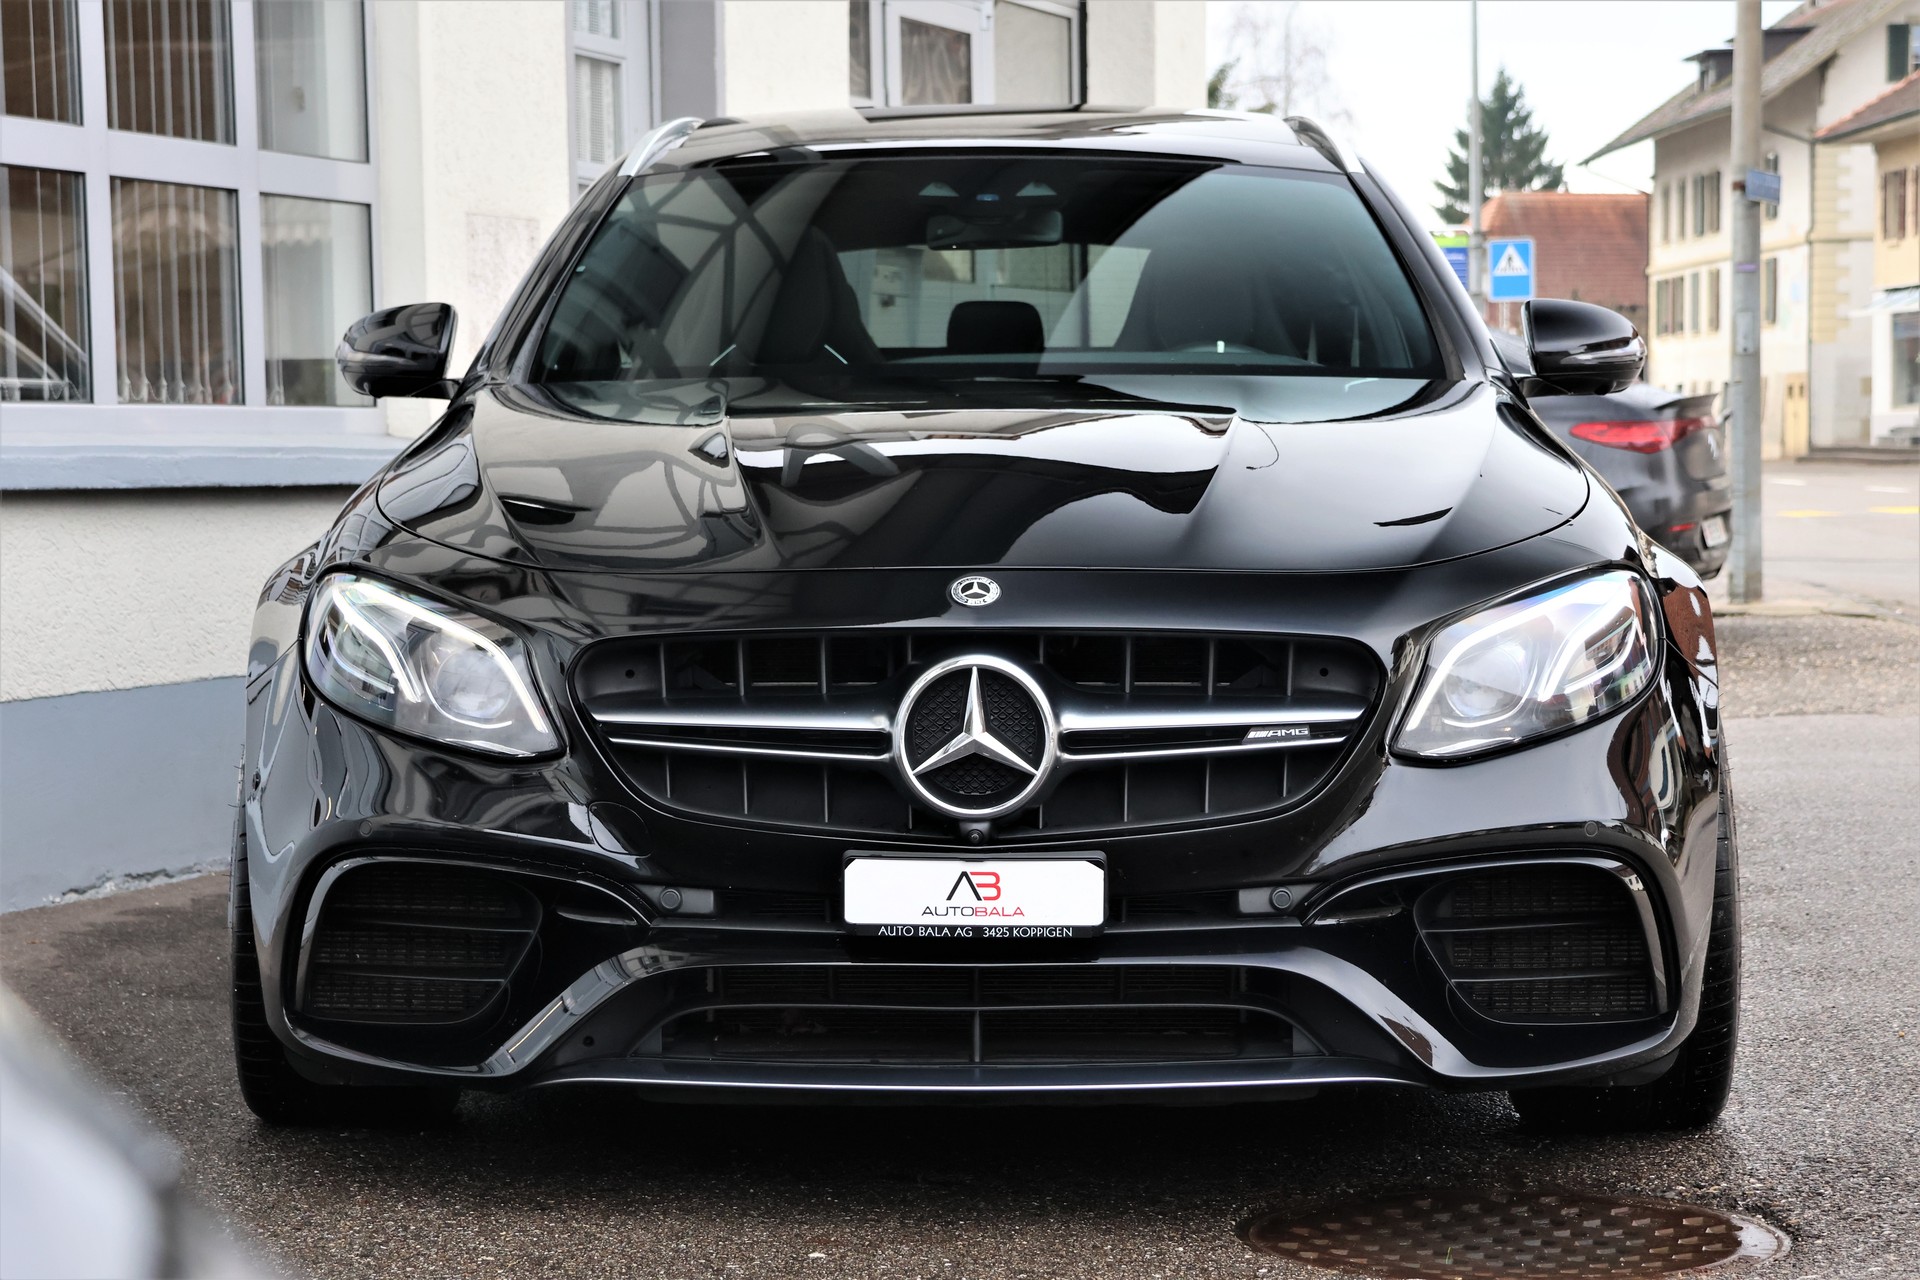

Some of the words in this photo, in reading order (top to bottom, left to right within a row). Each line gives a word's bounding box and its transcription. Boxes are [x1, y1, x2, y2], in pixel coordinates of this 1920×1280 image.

[1267, 728, 1309, 737] AMG
[921, 906, 1025, 917] AUTOBALA
[878, 926, 914, 936] AUTO
[918, 926, 951, 937] BALA
[954, 927, 973, 938] AG
[982, 927, 1010, 938] 3425
[1013, 927, 1073, 938] KOPPIGEN
